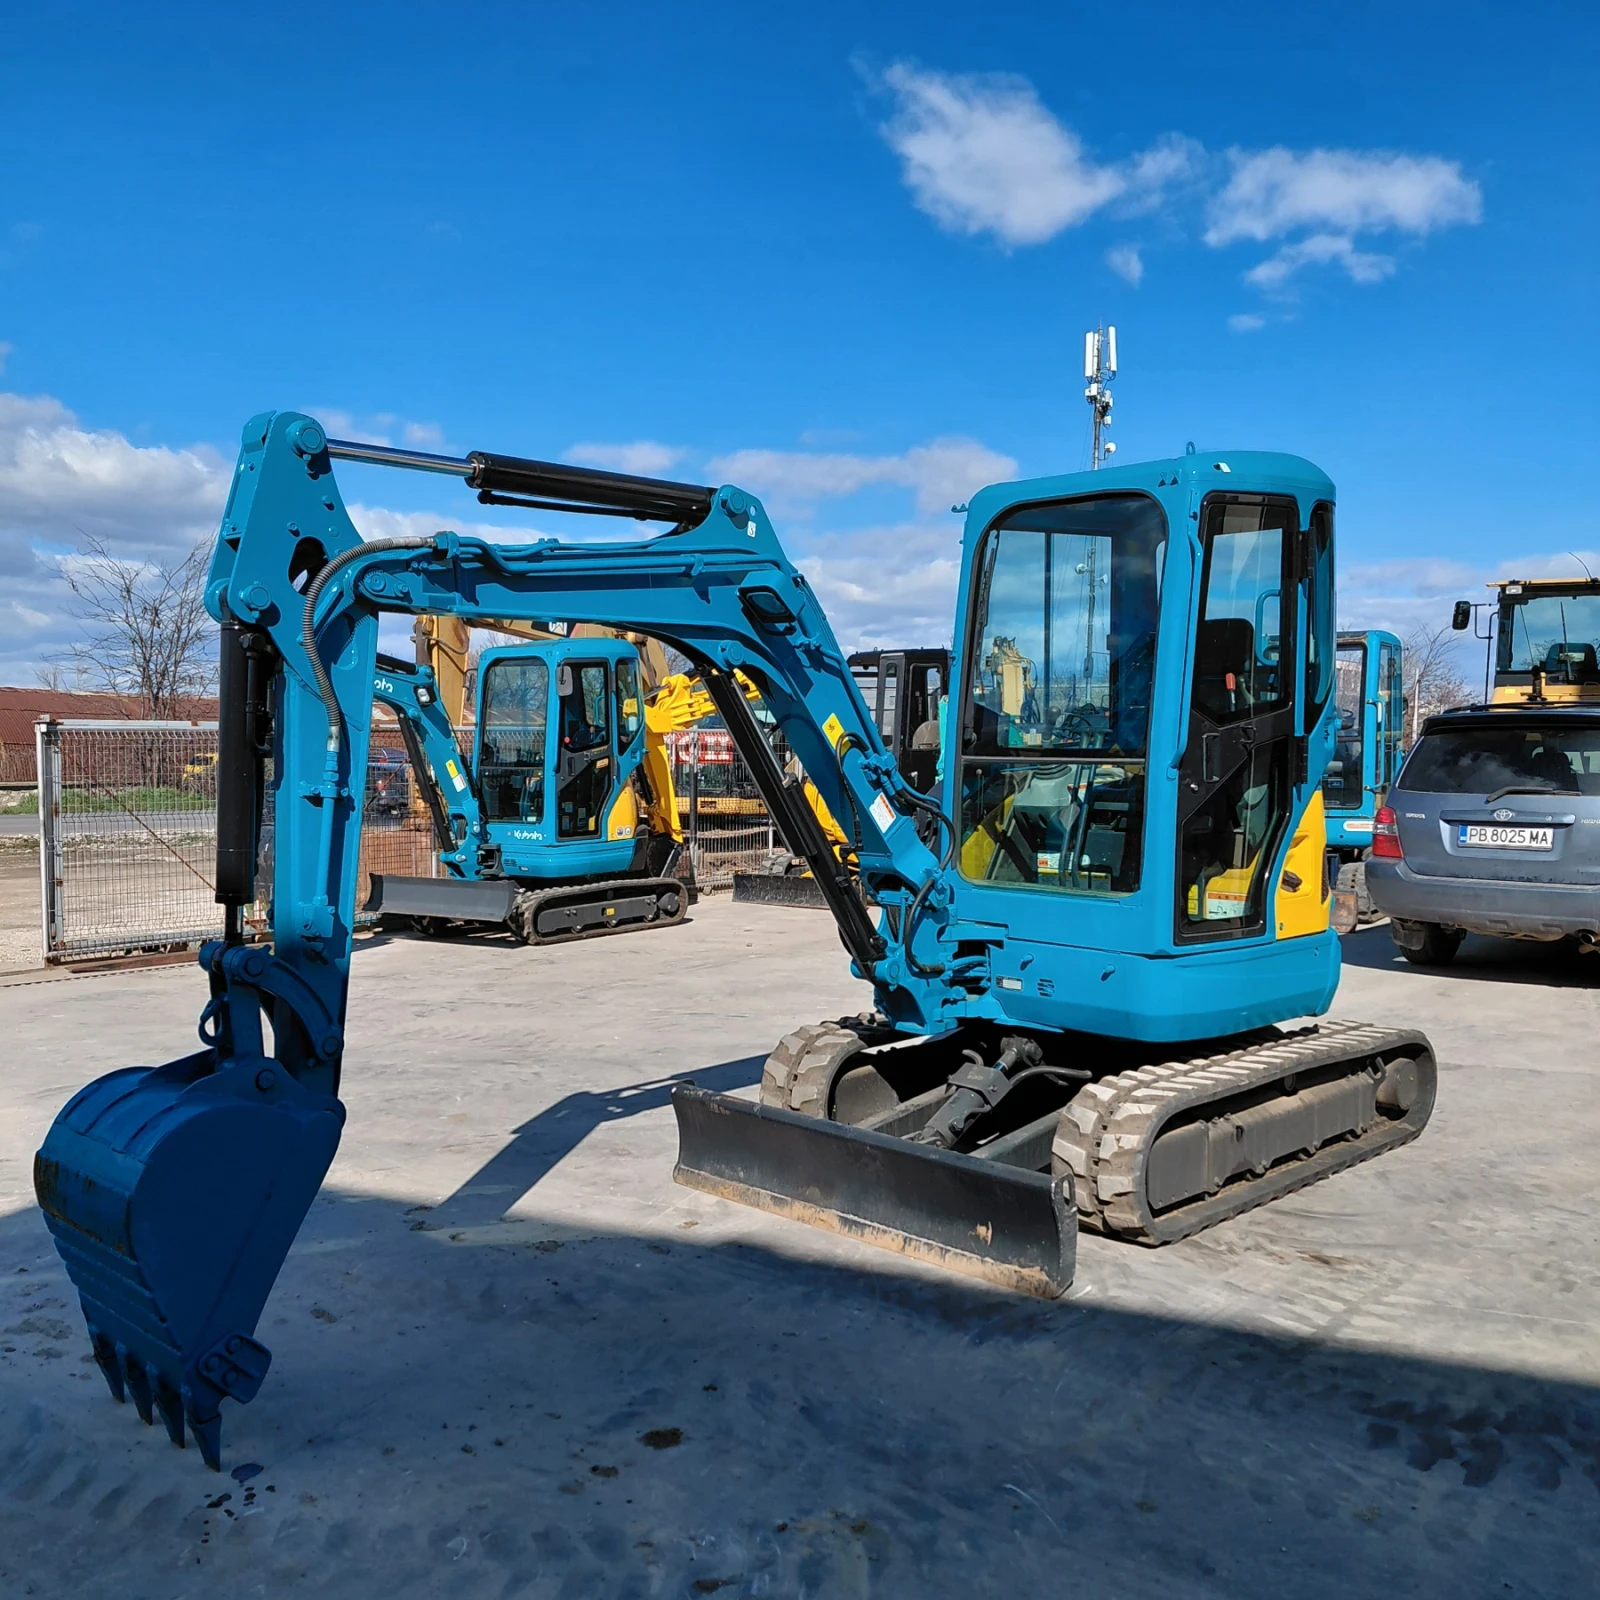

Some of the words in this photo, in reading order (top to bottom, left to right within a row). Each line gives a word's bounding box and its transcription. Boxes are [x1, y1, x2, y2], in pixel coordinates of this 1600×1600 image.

[513, 829, 543, 841] Kubota
[1468, 828, 1487, 842] PB
[1490, 829, 1526, 844] 8025
[1529, 830, 1548, 845] MA
